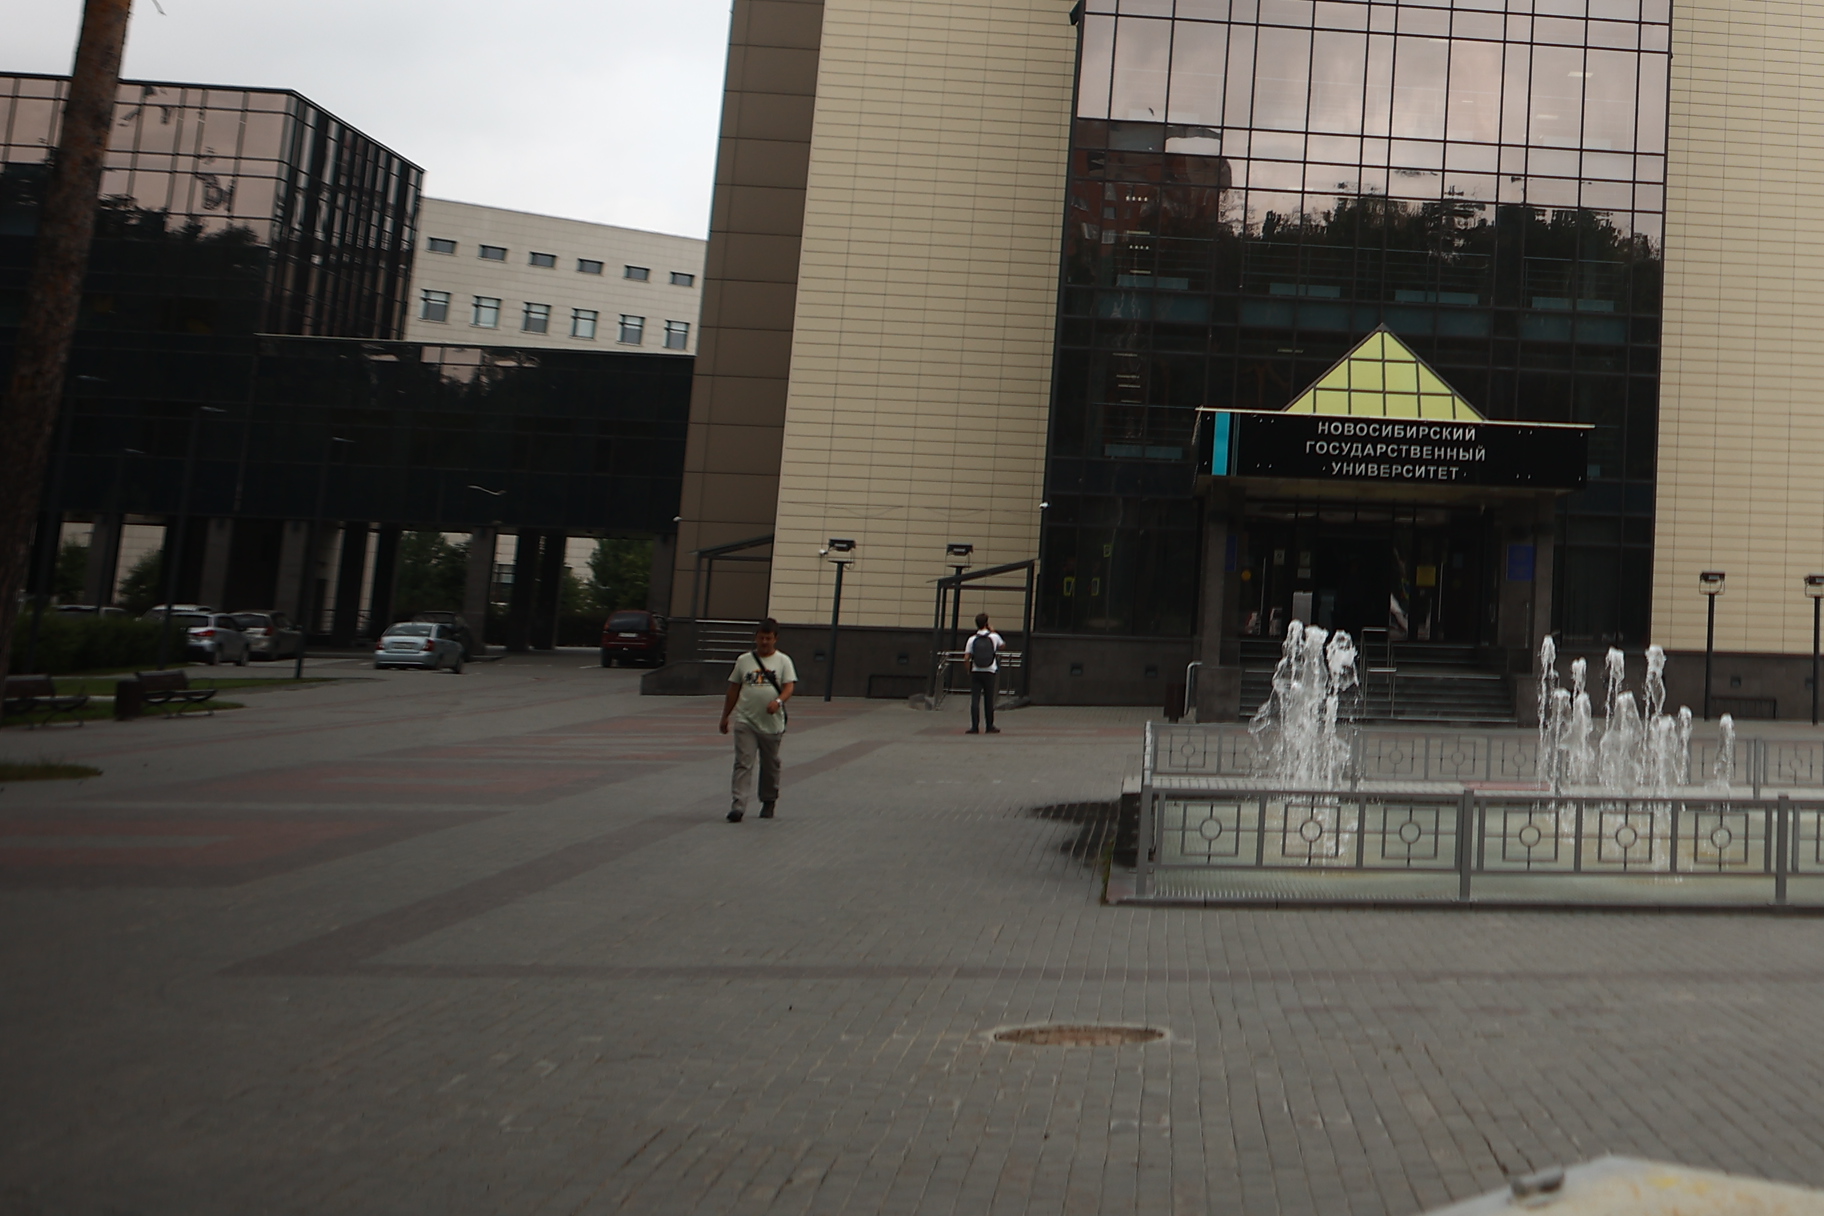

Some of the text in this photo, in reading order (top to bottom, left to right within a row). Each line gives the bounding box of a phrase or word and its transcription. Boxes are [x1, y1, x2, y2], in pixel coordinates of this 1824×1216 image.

[1318, 421, 1476, 442] НОВОСИБИРСКИЙ
[1305, 440, 1486, 462] ГОСУДАРСТВЕННЫЙ
[1331, 461, 1459, 480] УНИВЕРСИТЕТ
